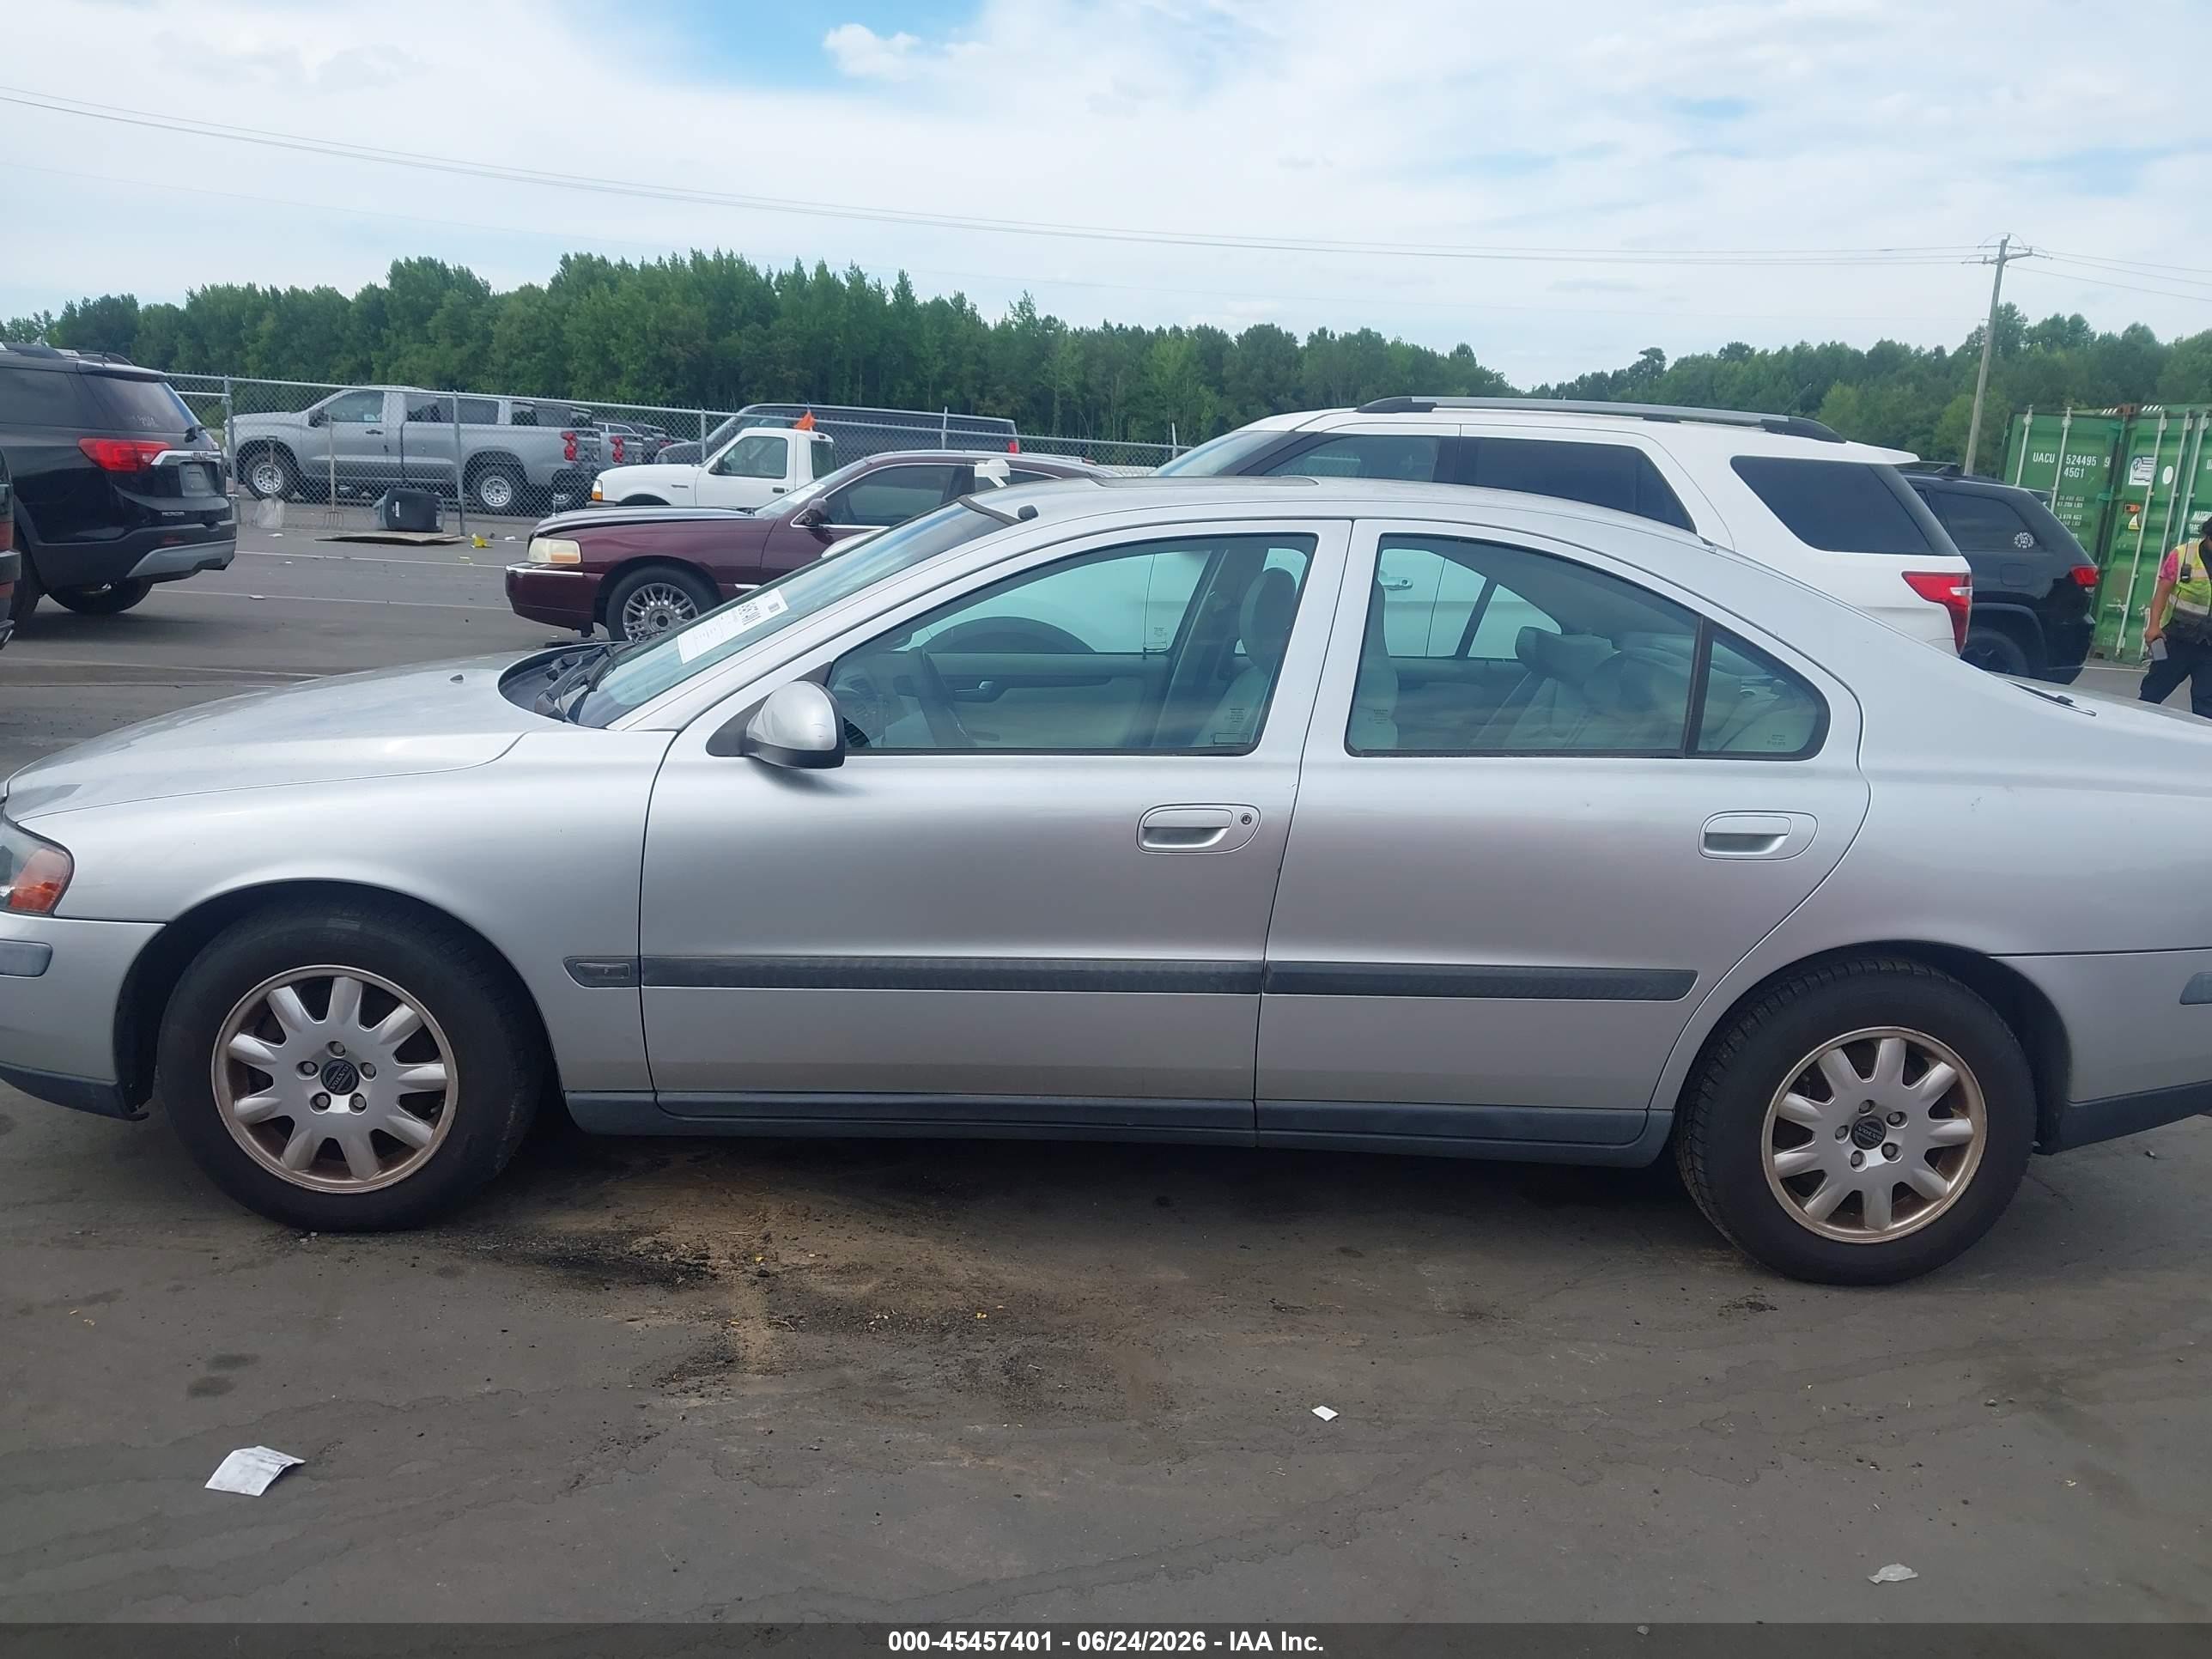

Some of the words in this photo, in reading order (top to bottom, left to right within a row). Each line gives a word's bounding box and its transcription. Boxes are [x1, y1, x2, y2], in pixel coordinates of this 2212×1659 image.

[2033, 452, 2056, 464] UACU
[2065, 453, 2097, 466] 524495
[2103, 456, 2112, 467] 9
[2063, 467, 2085, 478] 45G1
[329, 1065, 349, 1091] VOLVO
[1857, 1126, 1882, 1141] VOLVO
